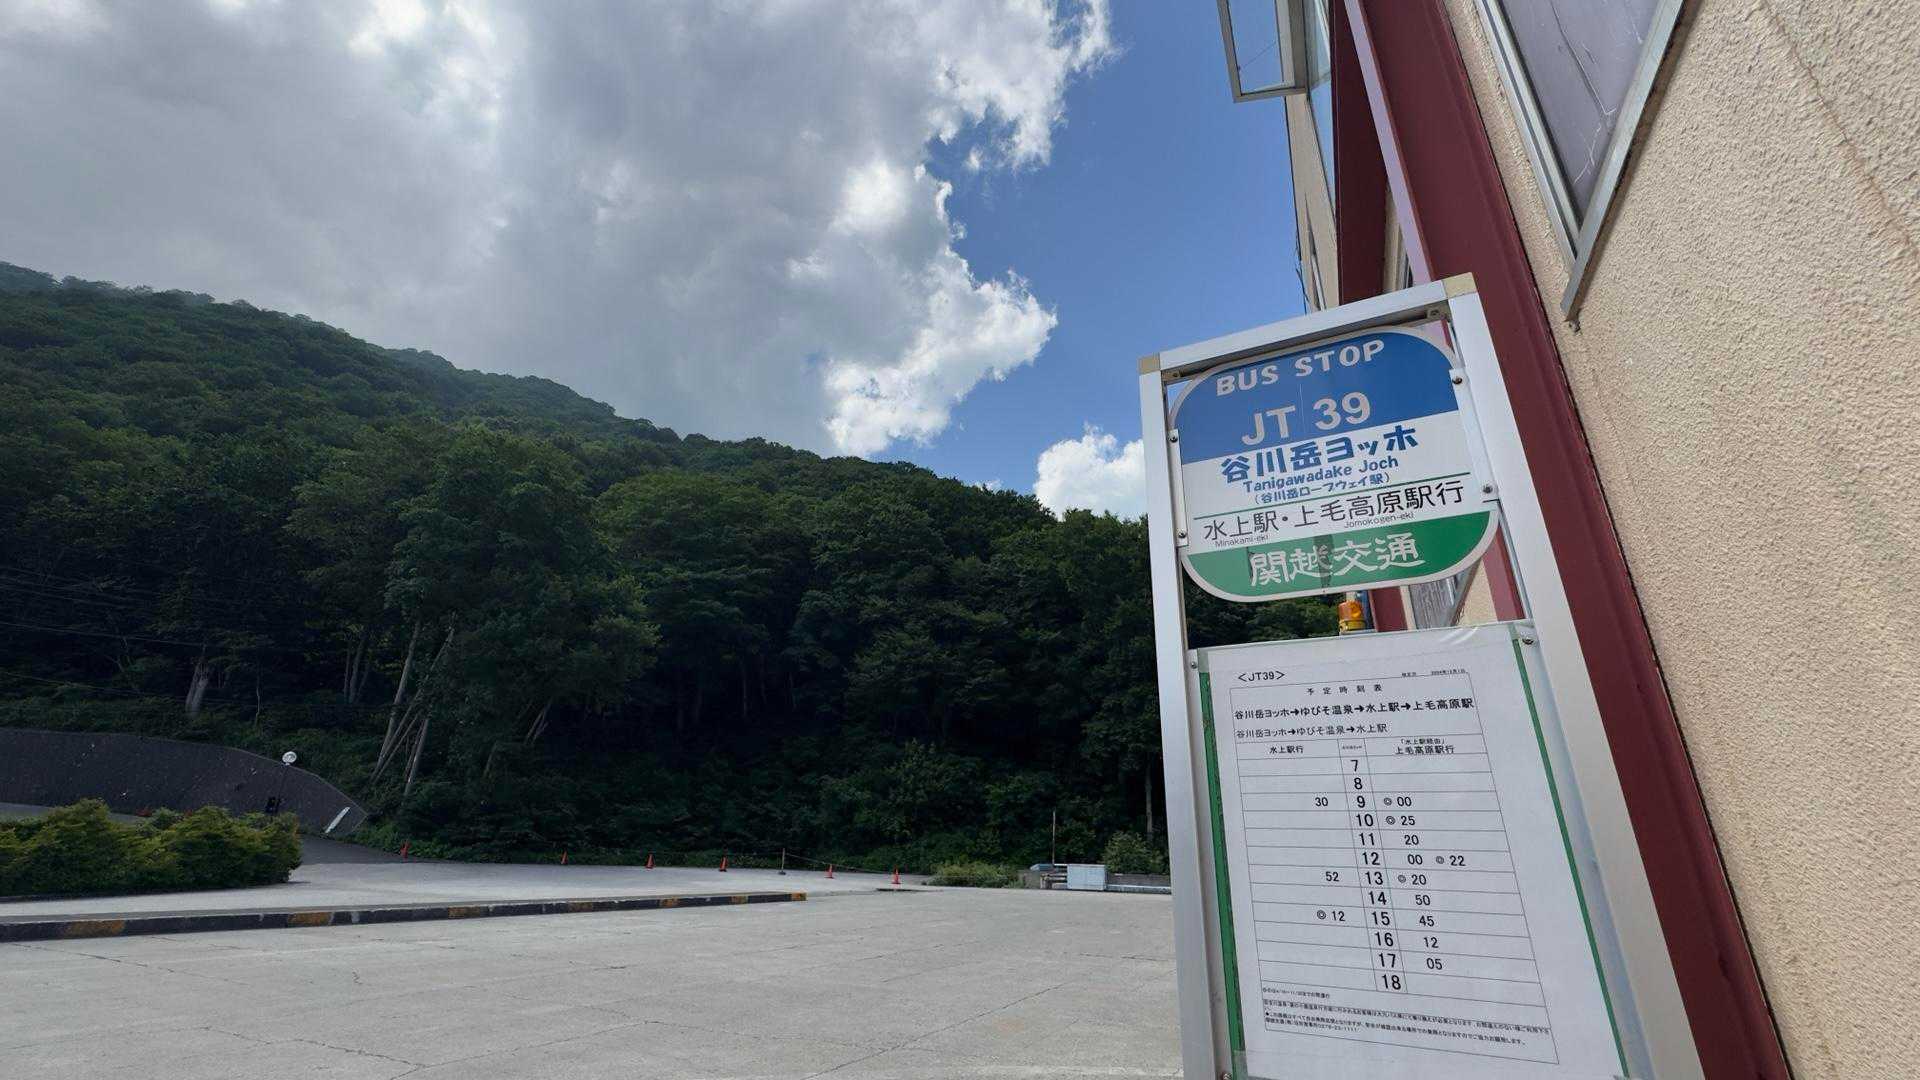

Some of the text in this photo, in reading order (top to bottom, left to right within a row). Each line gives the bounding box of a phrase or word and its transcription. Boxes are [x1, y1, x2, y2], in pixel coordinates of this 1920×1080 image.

[1216, 339, 1385, 396] BUS STOP
[1241, 391, 1371, 445] JT 39
[1220, 424, 1418, 483] 谷川岳ヨッホ
[1243, 455, 1399, 494] Tanigawadake Joch
[1344, 511, 1415, 529] Jomokogen-eki
[1214, 534, 1269, 548] Minakami-eki
[1251, 532, 1425, 587] 関越交通
[1269, 745, 1304, 755] 水上駅行
[1395, 745, 1455, 755] 上毛高原駅行
[1350, 759, 1359, 772] 7
[1353, 777, 1363, 790] 8
[1314, 796, 1329, 807] 30
[1356, 795, 1366, 808] 9
[1396, 796, 1412, 807] 00
[1355, 813, 1374, 827] 10
[1400, 815, 1416, 826] 25
[1359, 833, 1375, 846] 11
[1404, 834, 1420, 845] 20
[1362, 852, 1381, 866] 12
[1407, 854, 1423, 865] 00
[1449, 855, 1466, 867] 22
[1325, 871, 1339, 882] 52
[1365, 871, 1384, 885] 13
[1411, 874, 1427, 885] 20
[1368, 891, 1387, 905] 14
[1415, 894, 1431, 906] 50
[1332, 911, 1346, 922] 12
[1371, 911, 1390, 926] 15
[1419, 915, 1435, 927] 45
[1374, 932, 1394, 947] 16
[1423, 937, 1439, 949] 12
[1378, 953, 1396, 968] 17
[1426, 957, 1443, 970] 05
[1381, 974, 1402, 990] 18
